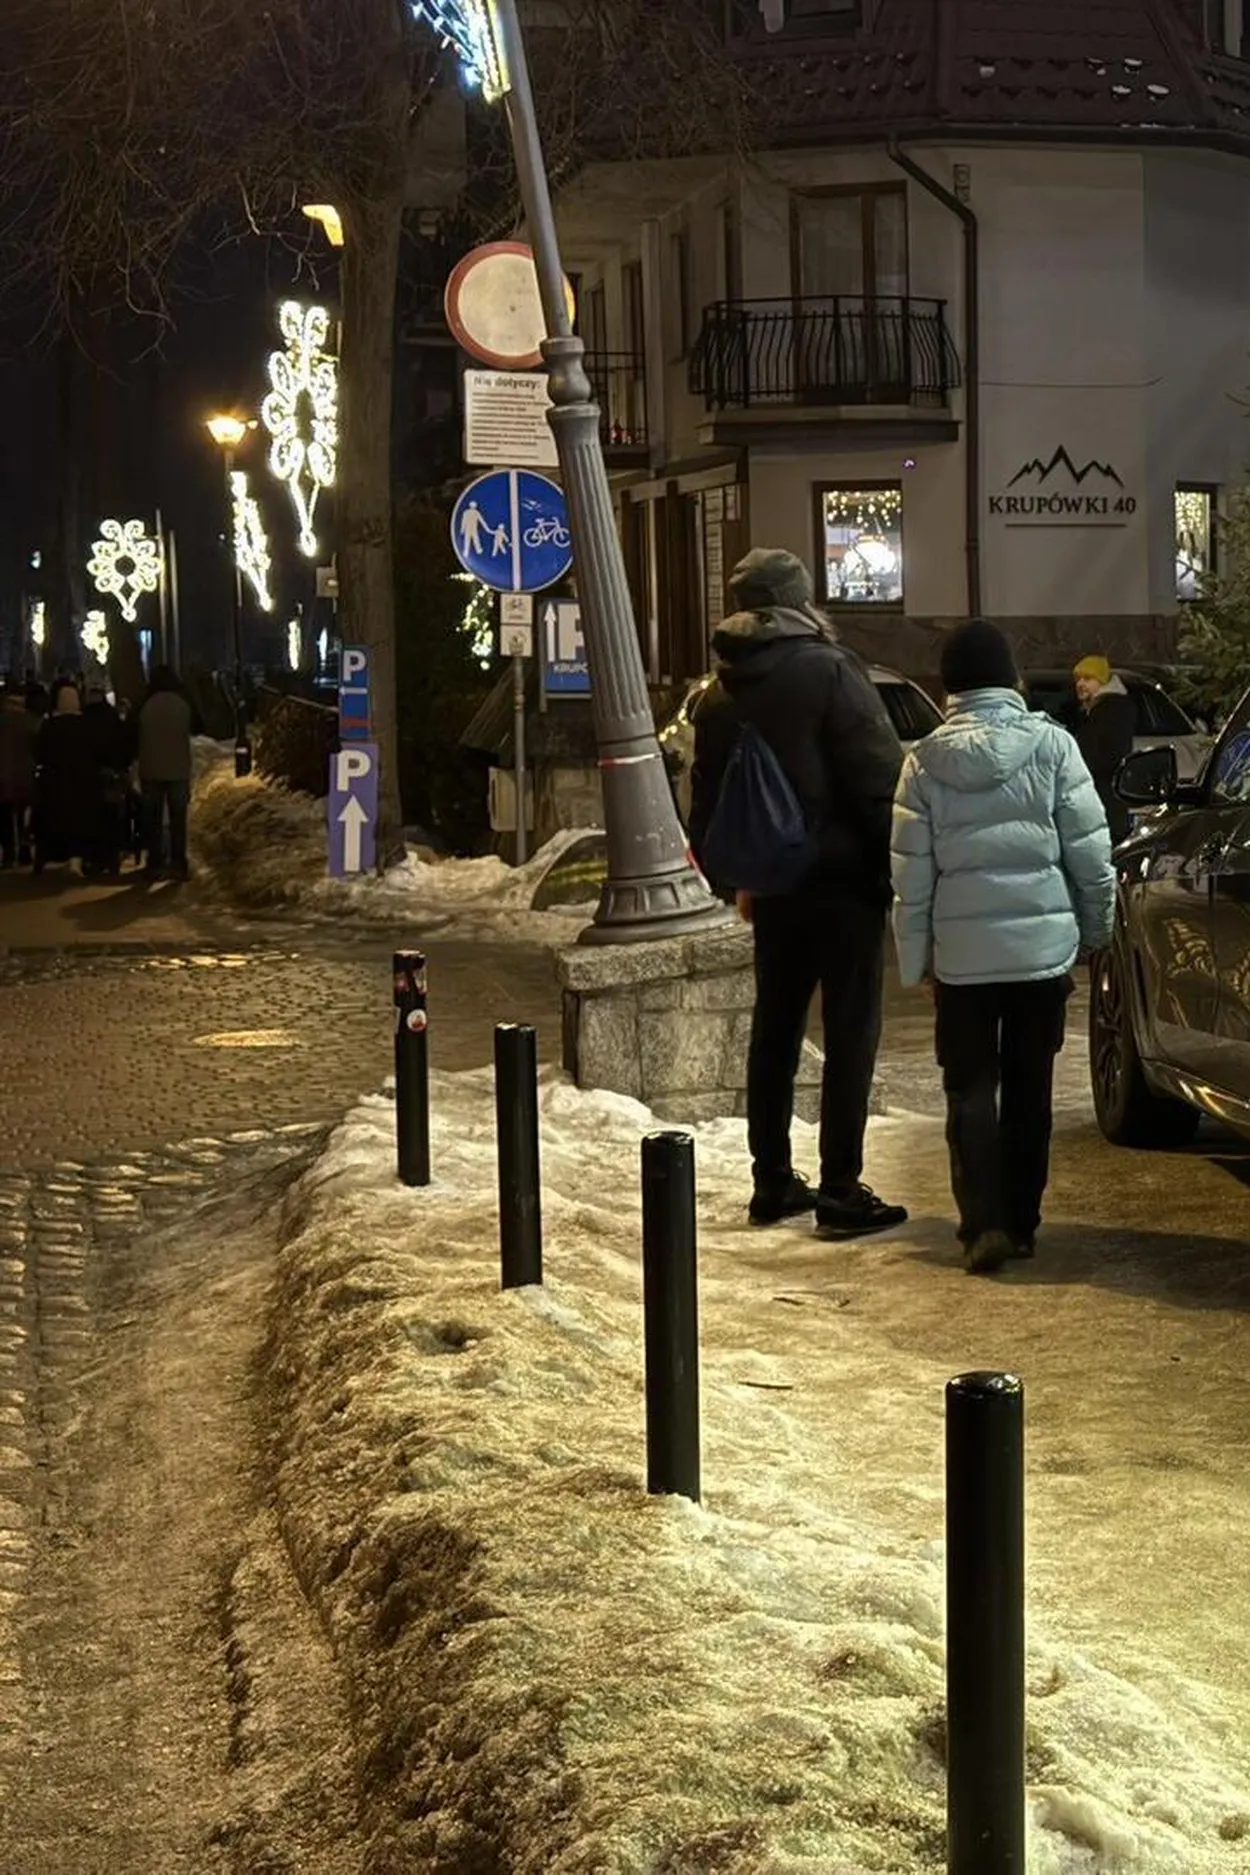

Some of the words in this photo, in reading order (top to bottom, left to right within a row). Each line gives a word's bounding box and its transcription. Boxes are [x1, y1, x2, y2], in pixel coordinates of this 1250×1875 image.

[988, 491, 1108, 514] KRUPÓWKI
[1114, 497, 1137, 514] 40
[343, 650, 366, 681] P
[337, 750, 371, 791] P
